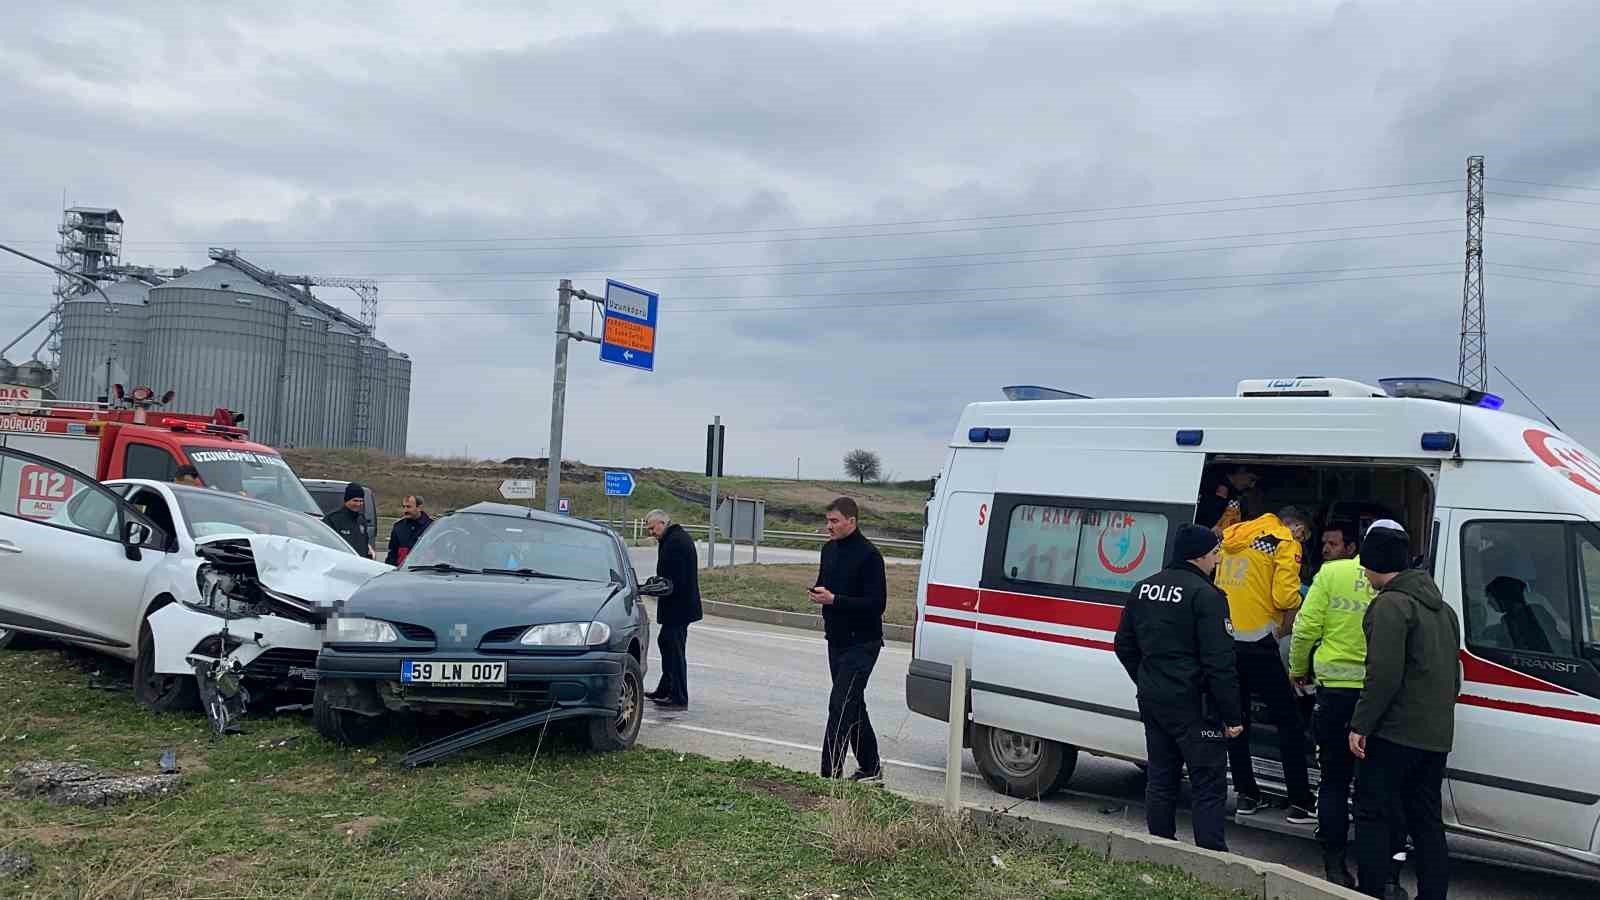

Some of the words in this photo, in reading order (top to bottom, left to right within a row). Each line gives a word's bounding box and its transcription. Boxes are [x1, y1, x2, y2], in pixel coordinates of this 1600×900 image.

[28, 471, 65, 497] 112
[412, 664, 432, 680] 59
[442, 664, 461, 680] LN
[472, 664, 502, 680] 007
[1512, 654, 1579, 673] TRANSIT
